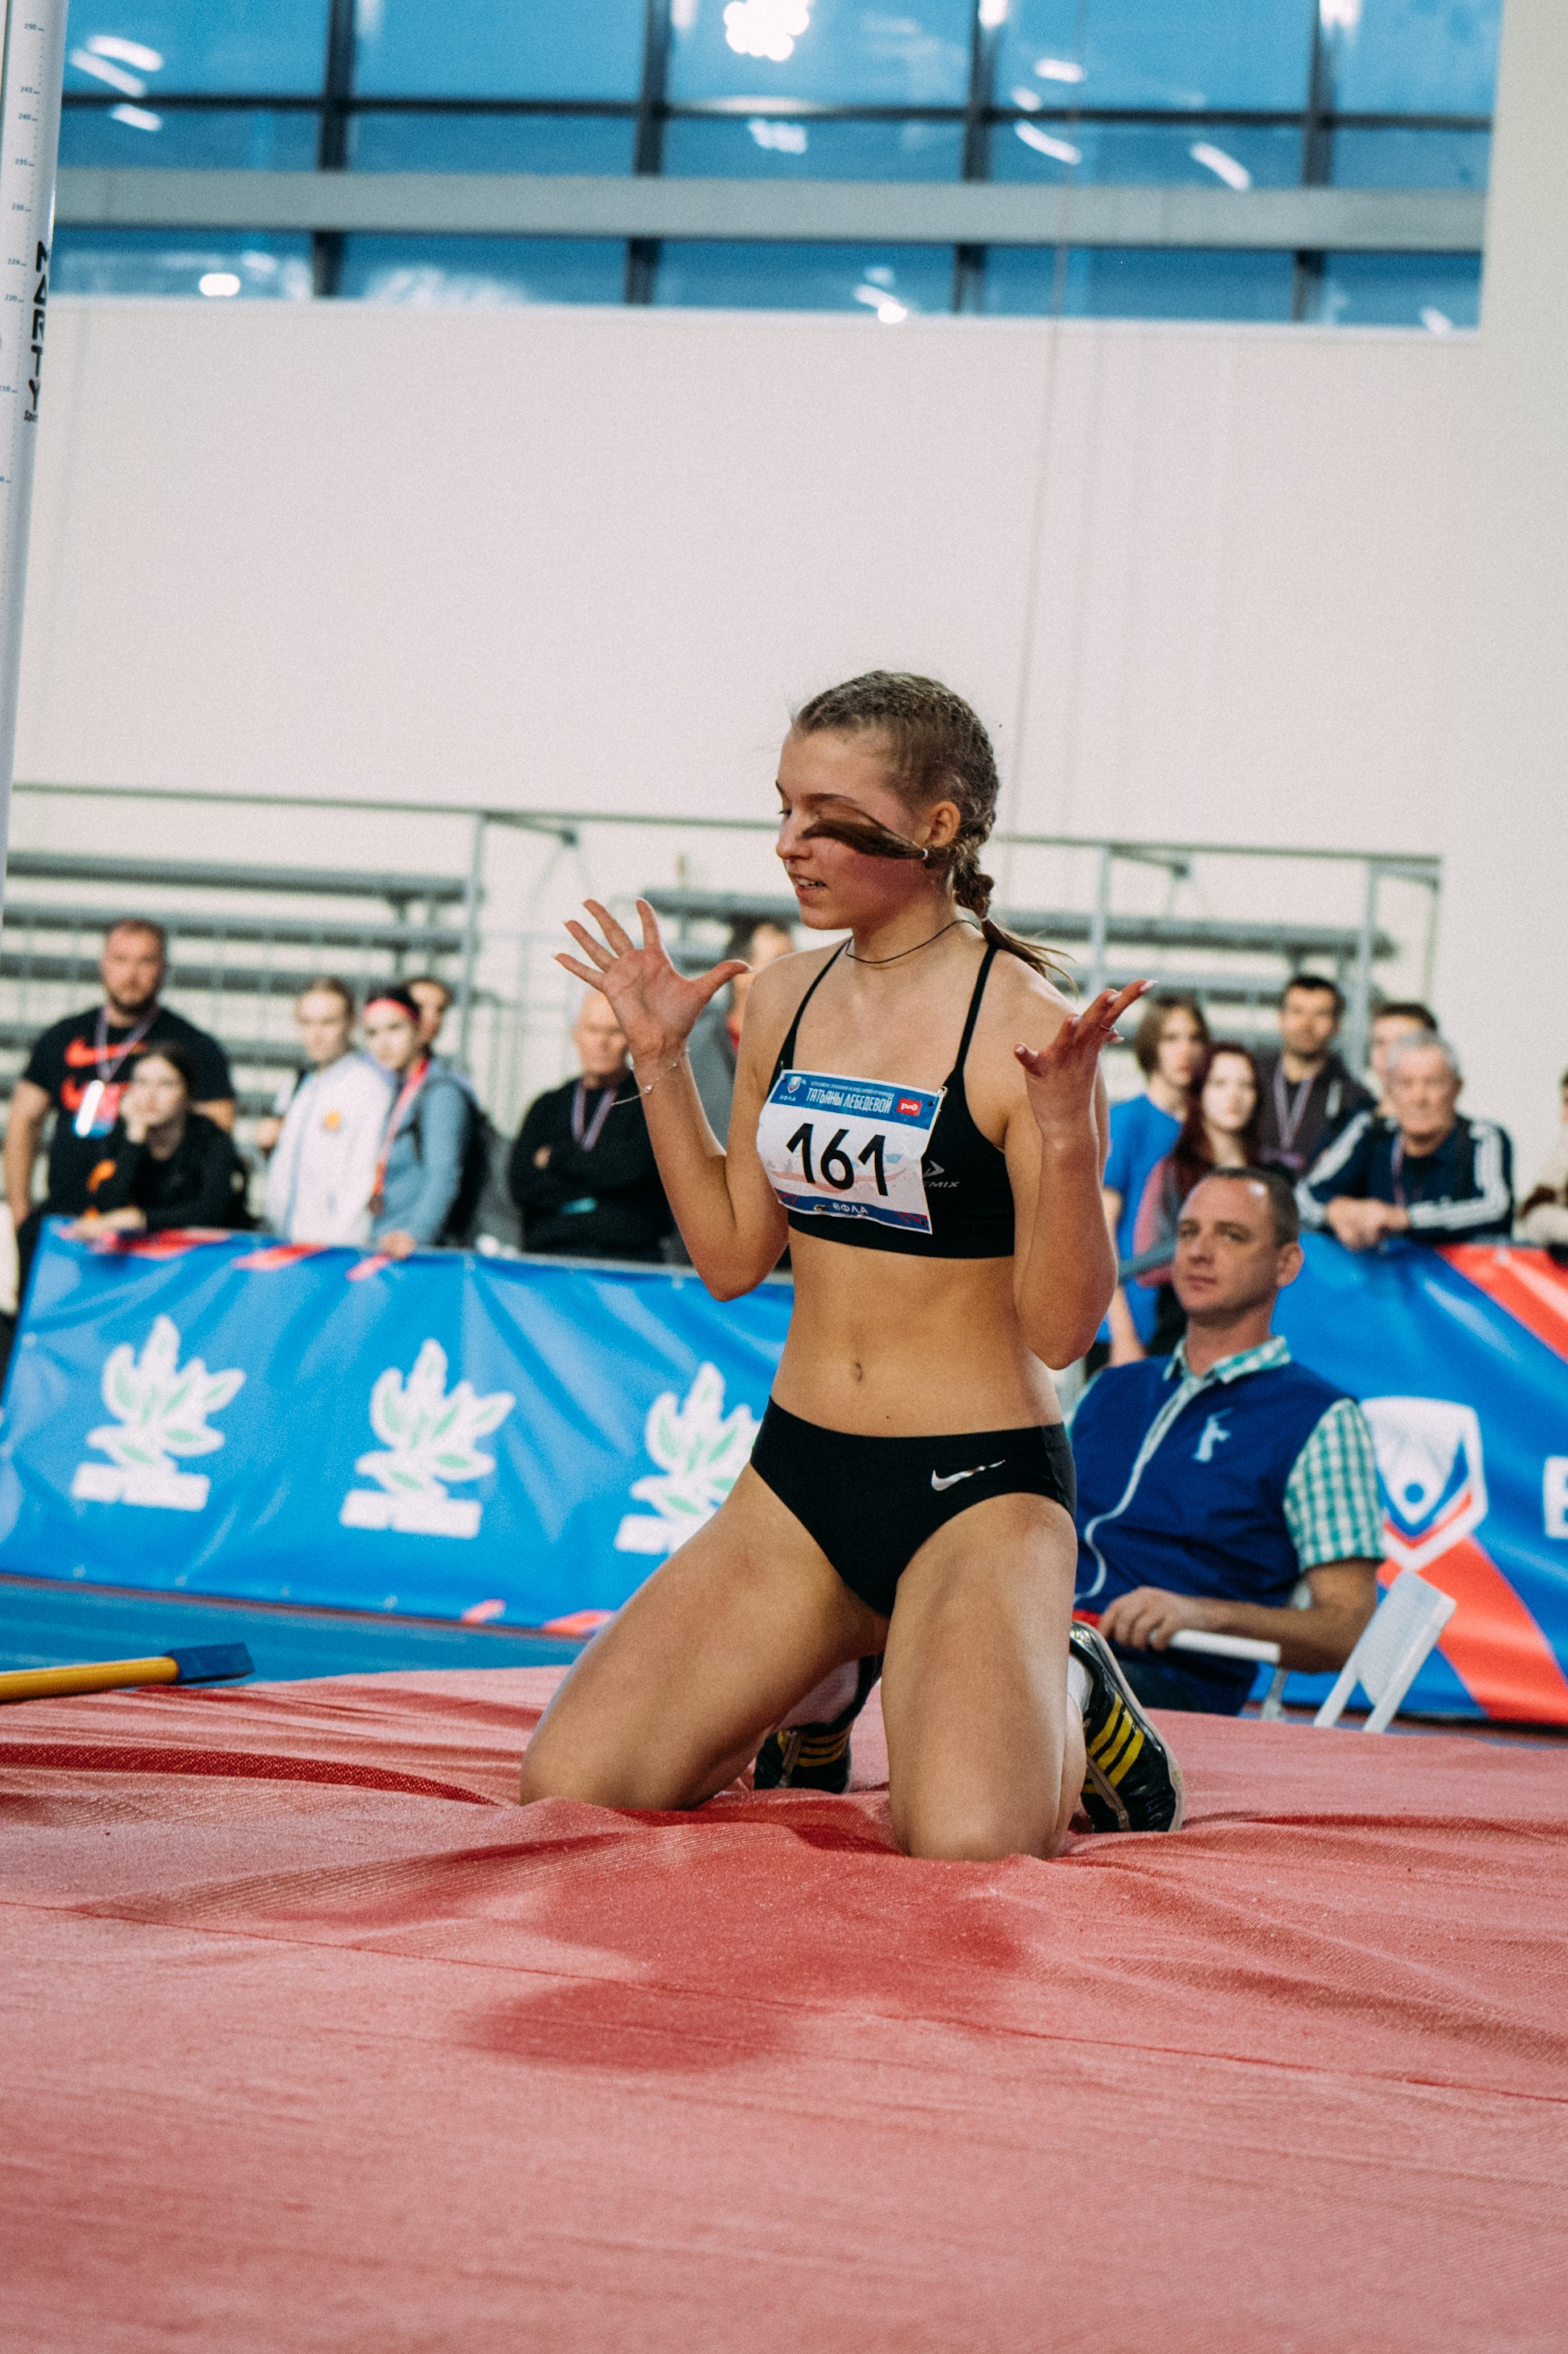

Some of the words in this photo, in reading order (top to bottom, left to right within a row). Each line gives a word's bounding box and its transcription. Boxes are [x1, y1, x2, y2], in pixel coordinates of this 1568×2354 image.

[806, 1087, 845, 1108] ТАТЬЯНЫ
[843, 1093, 895, 1115] ЛЕБЕДЕВОЙ
[786, 1122, 888, 1197] 161
[832, 1201, 869, 1214] ВФЛА
